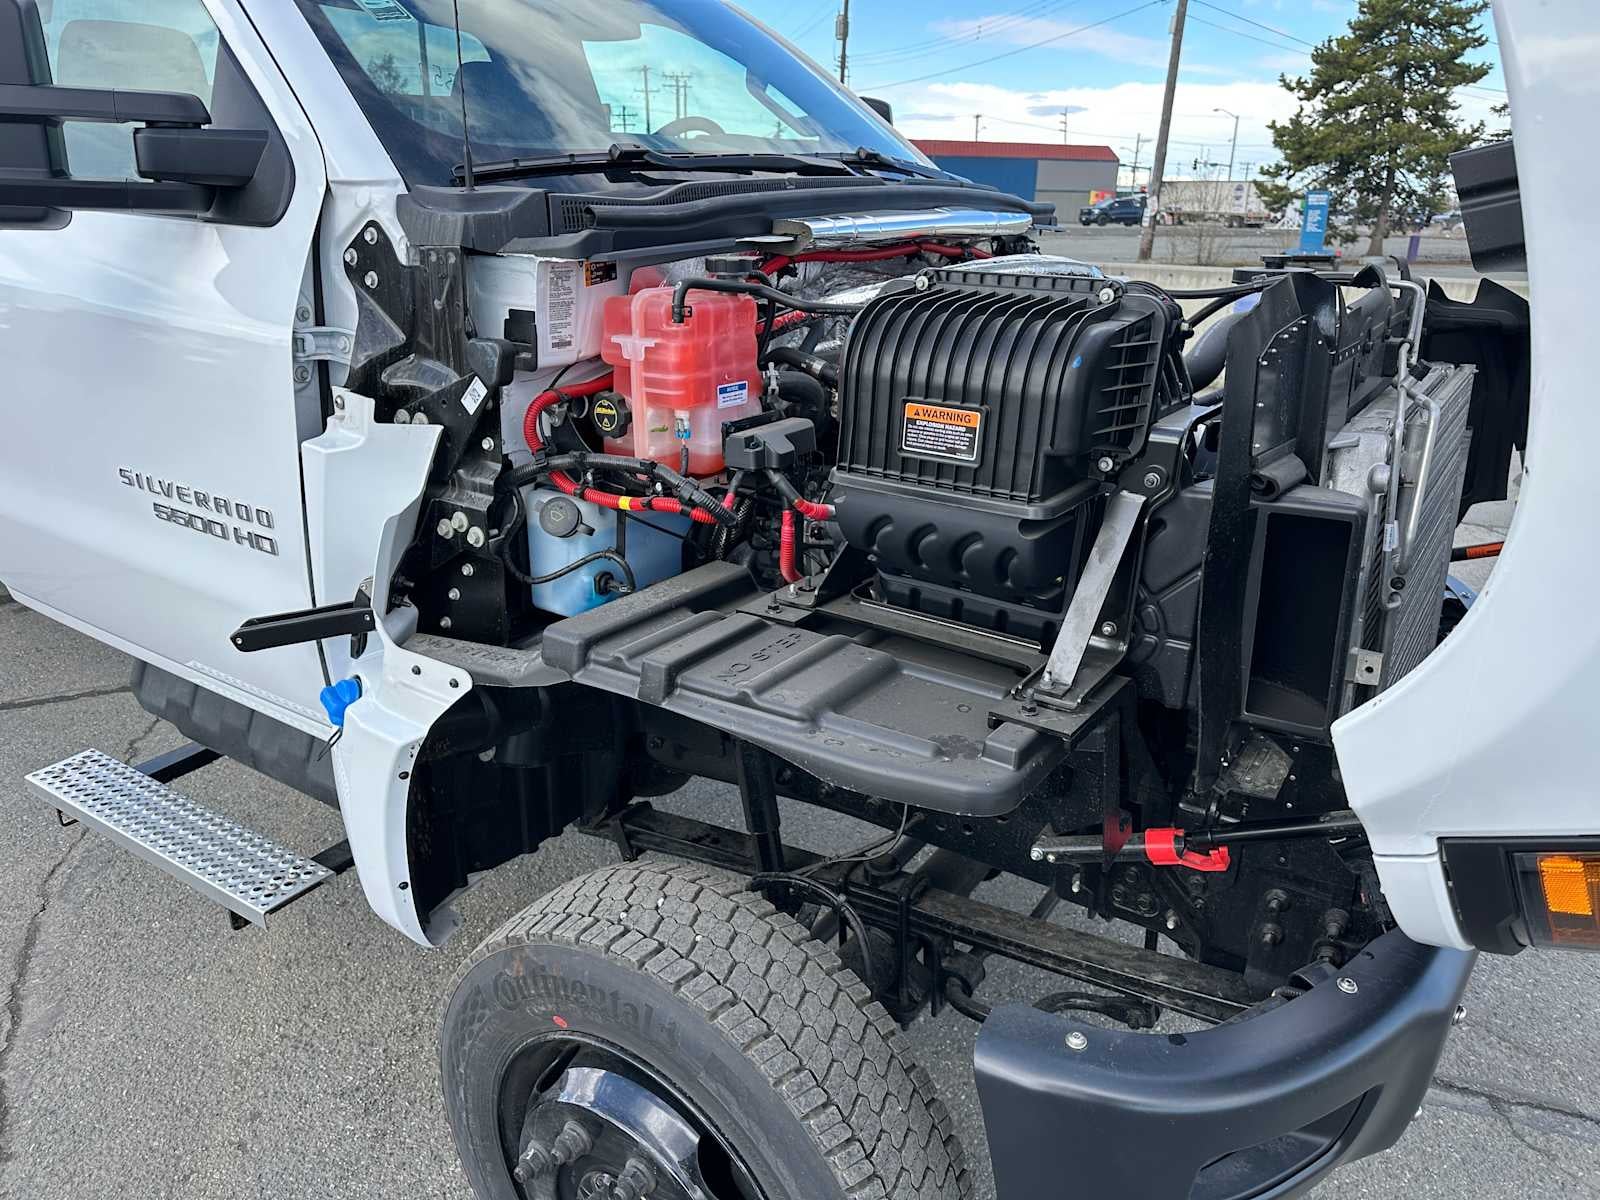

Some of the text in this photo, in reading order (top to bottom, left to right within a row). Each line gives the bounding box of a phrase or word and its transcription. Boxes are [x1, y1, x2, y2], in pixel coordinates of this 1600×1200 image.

[916, 420, 945, 429] EXPLOSION
[945, 424, 966, 433] HAZARD
[922, 408, 972, 424] WARNING
[118, 467, 275, 529] SILVERADO
[153, 502, 279, 556] 5500 HD
[711, 633, 801, 685] NO STEP
[493, 966, 656, 1035] Continental
